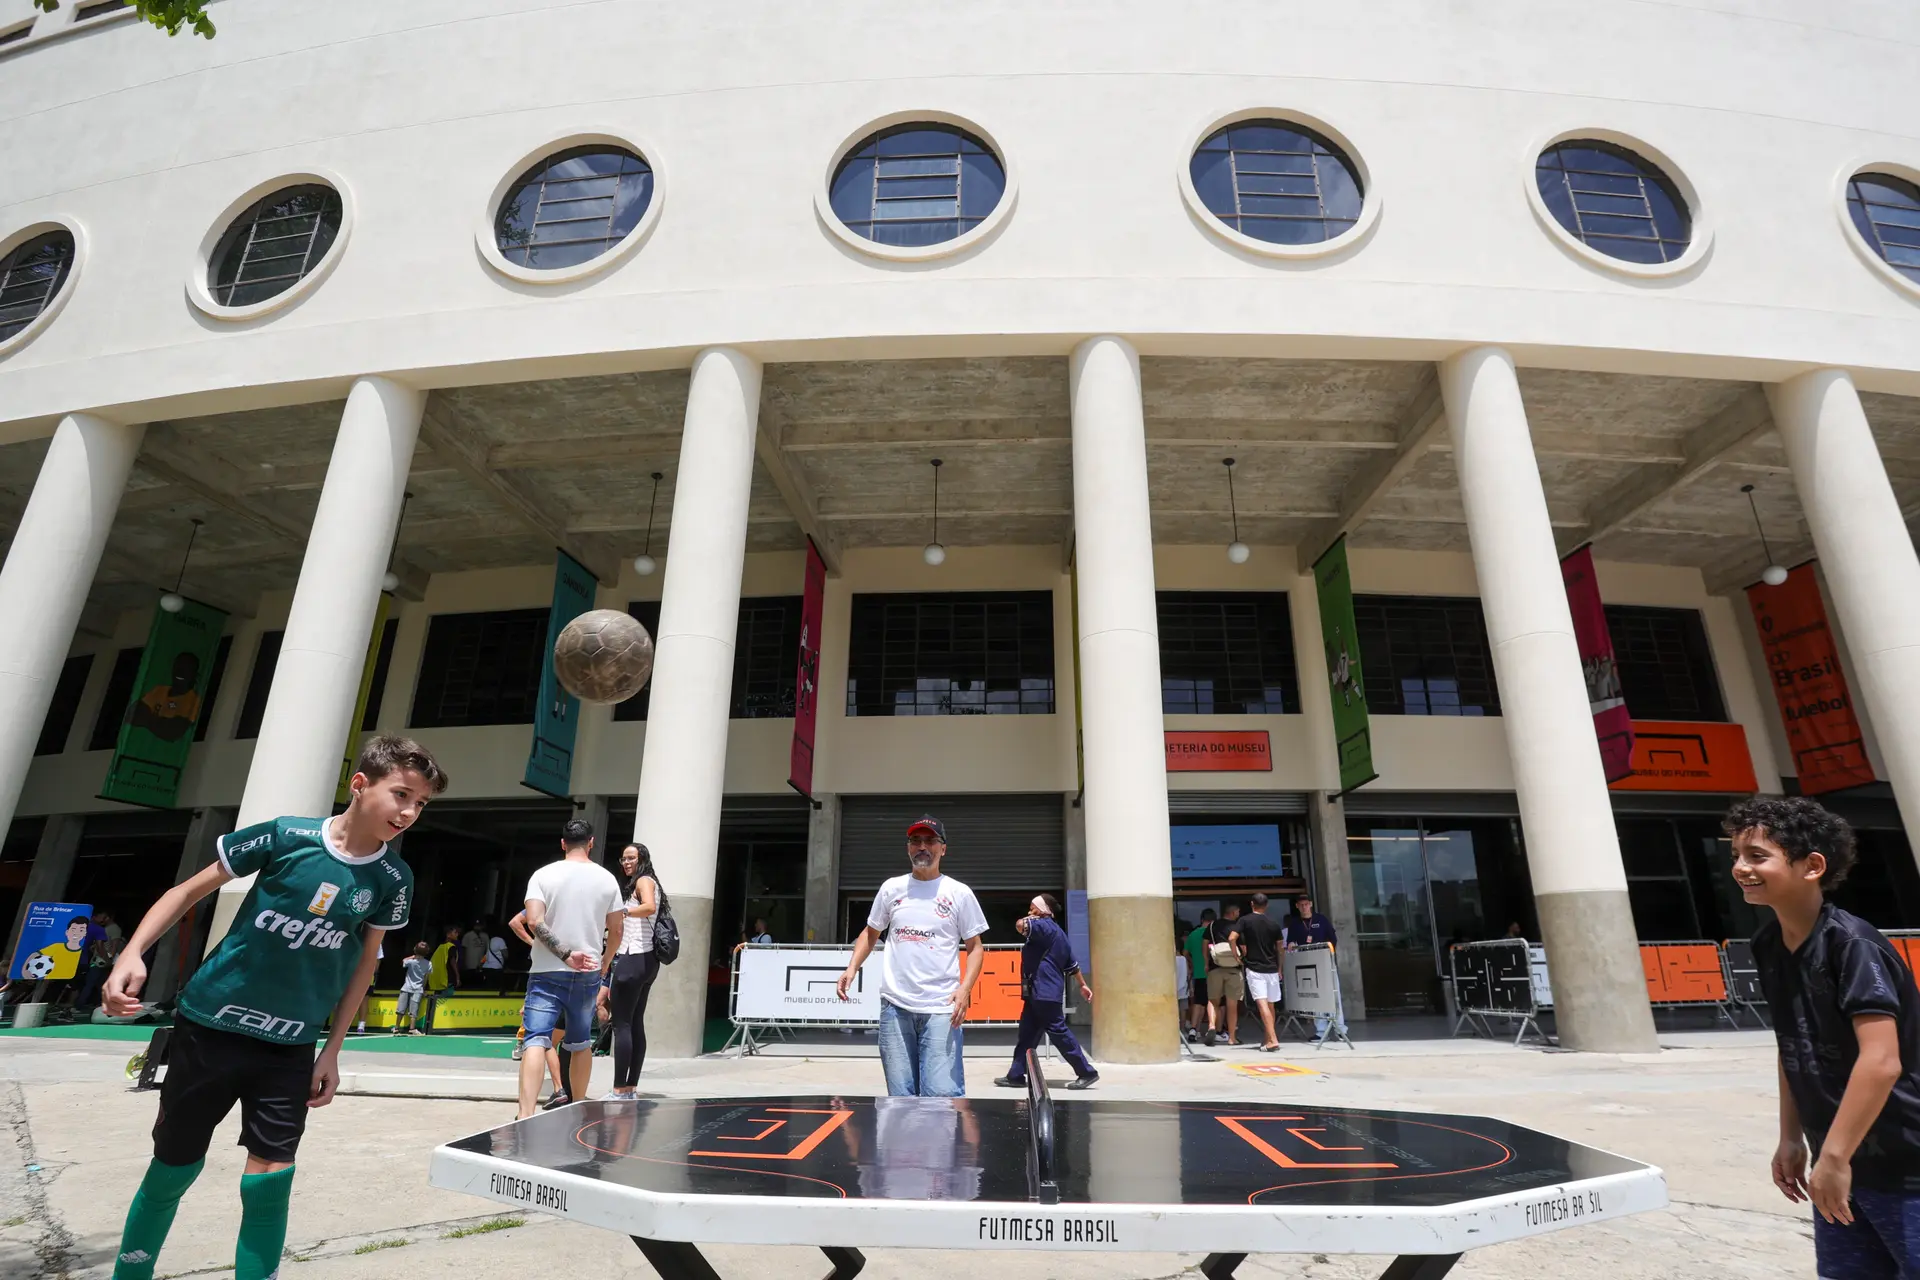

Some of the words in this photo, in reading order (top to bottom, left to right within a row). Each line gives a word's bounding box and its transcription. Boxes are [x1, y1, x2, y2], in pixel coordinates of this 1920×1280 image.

[1775, 655, 1840, 687] Brasil
[1210, 743, 1226, 753] DO
[1228, 743, 1266, 753] MUSEU
[380, 859, 402, 881] crefisa
[254, 909, 350, 950] crefisa
[490, 1173, 532, 1202] FUTMESA
[536, 1183, 568, 1212] BRASIL
[1525, 1198, 1568, 1227] FUTMESA
[1572, 1191, 1603, 1217] BRSIL
[979, 1217, 1053, 1241] FUTMESA
[1064, 1219, 1119, 1242] BRASIL
